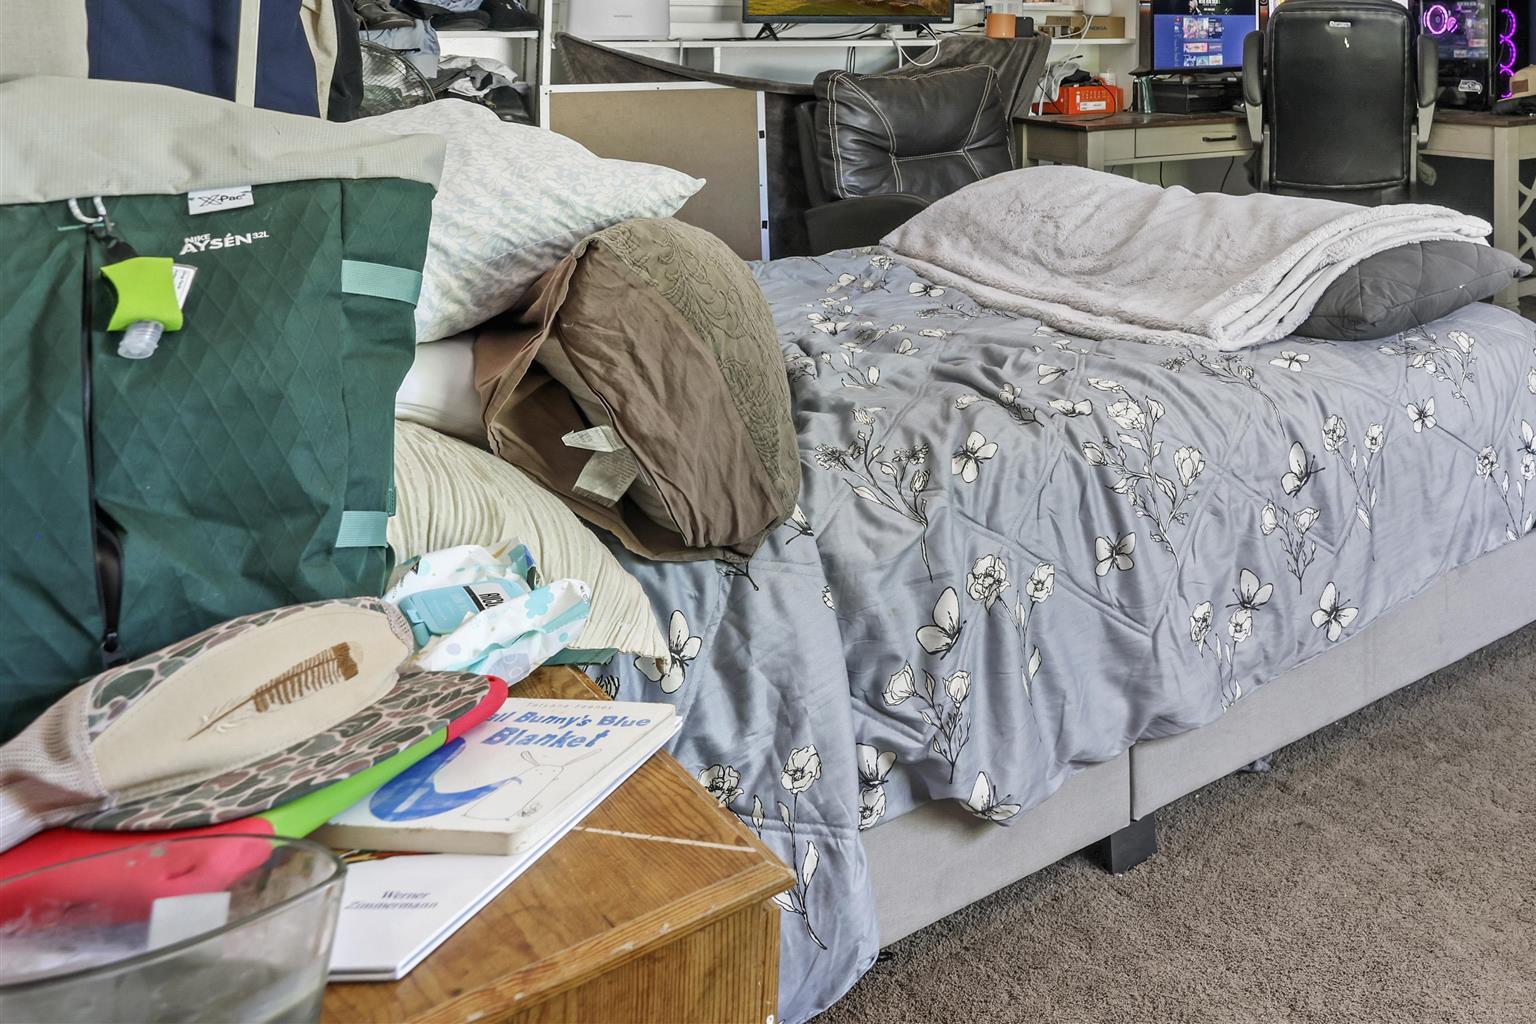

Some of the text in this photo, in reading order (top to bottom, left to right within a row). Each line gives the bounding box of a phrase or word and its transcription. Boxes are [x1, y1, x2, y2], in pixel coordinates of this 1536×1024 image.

[179, 230, 270, 255] AYSÉN 32L
[184, 233, 211, 244] NIKE
[514, 711, 593, 730] Bunny's
[597, 715, 651, 727] Blue
[480, 726, 611, 749] Blanket
